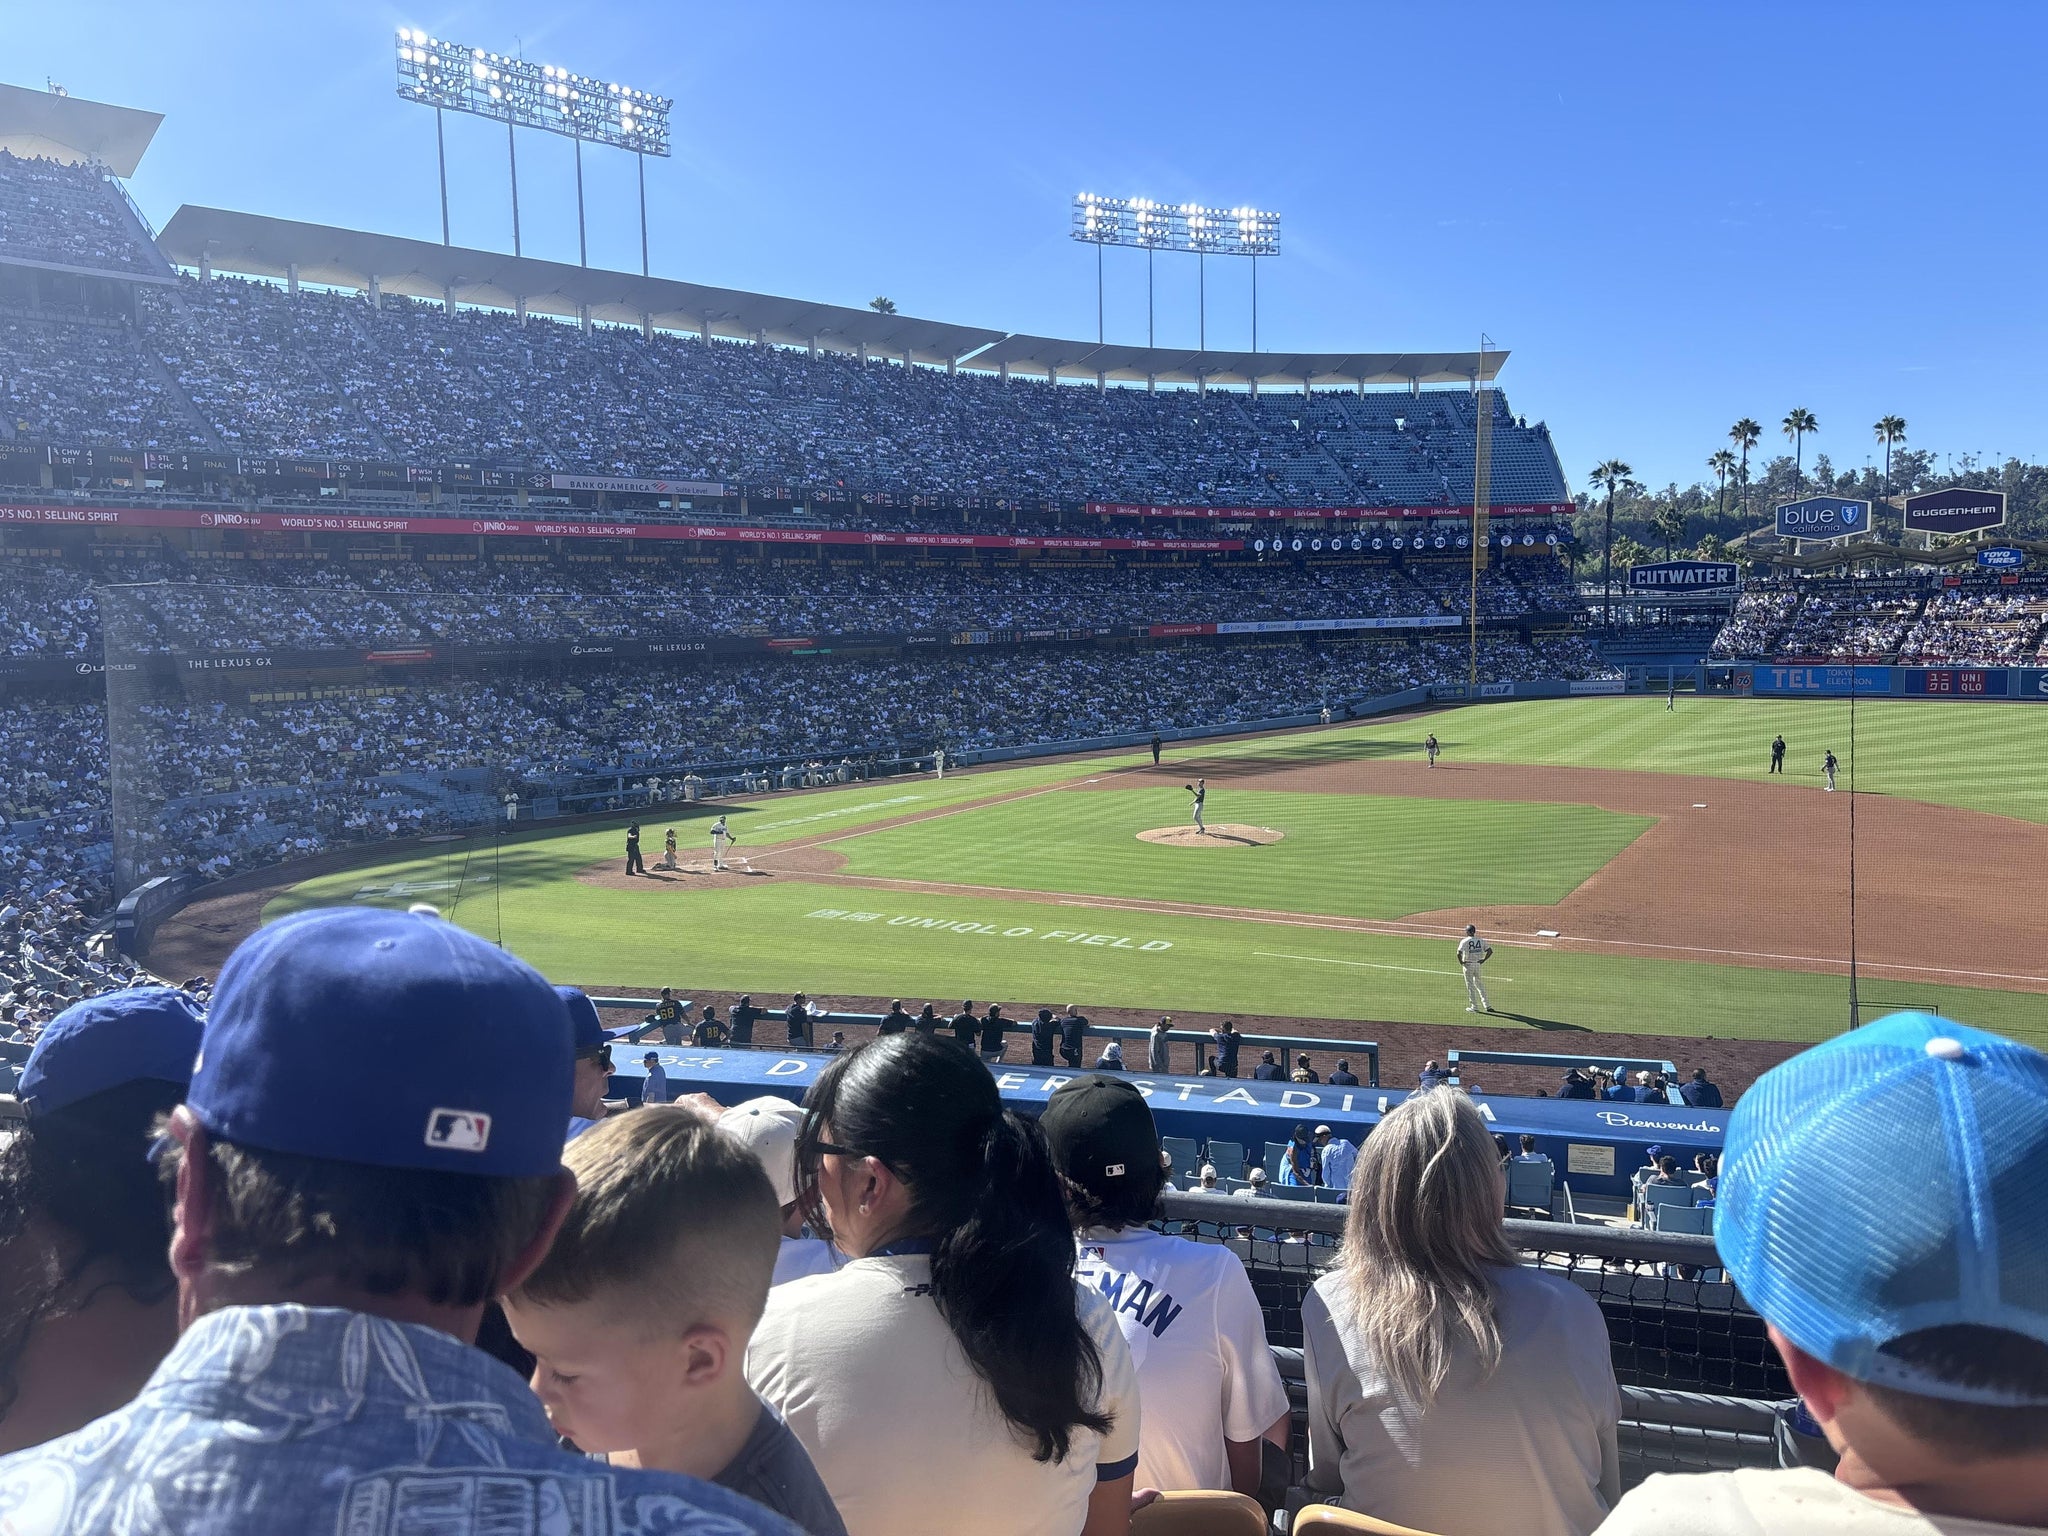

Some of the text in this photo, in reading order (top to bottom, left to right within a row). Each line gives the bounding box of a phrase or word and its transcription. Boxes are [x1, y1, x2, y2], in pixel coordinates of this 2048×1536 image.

[87, 458, 93, 466] 3
[109, 455, 134, 464] FINAL
[204, 461, 227, 469] FINAL
[378, 470, 398, 478] FINAL
[570, 481, 650, 492] BANK OF AMERICA
[675, 486, 708, 495] Suite Level
[17, 509, 41, 519] NO.1
[45, 510, 85, 520] SELLING
[87, 512, 119, 522] SPIRIT
[1785, 506, 1834, 525] blue
[1912, 506, 1996, 517] GUGGENHEIM
[214, 513, 242, 526] JINRO
[281, 518, 408, 530] WORLD'S NO.1 SELLING SPIRIT
[483, 522, 506, 532] JINRO
[535, 524, 637, 536] WORLD'S NO.1 SELLING SPIRIT
[1792, 524, 1840, 533] california
[697, 528, 716, 537] JINRO
[739, 530, 766, 538] WORLD'S
[781, 532, 805, 540] SELLING
[871, 534, 887, 543] JINRO
[1458, 538, 1466, 546] 42
[1636, 567, 1728, 584] CUTWATER
[1573, 614, 1587, 622] 4:41
[666, 643, 692, 651] LEXUS
[188, 657, 272, 669] THE LEXUS GX
[1736, 675, 1750, 686] 76
[1772, 669, 1820, 689] TEL
[1826, 678, 1872, 686] ELECTRON
[1930, 673, 1949, 681] ユニ
[1961, 673, 1981, 682] UNI
[1483, 685, 1501, 695] ANA
[1929, 683, 1949, 691] クロ
[1961, 683, 1982, 692] QLO
[887, 915, 1034, 937] UNIQLO
[1040, 929, 1173, 951] FIELD
[1468, 940, 1482, 950] 84
[660, 1007, 675, 1020] 68
[765, 1058, 1075, 1092] DER
[1596, 1111, 1721, 1133] Bienvenido
[1078, 1270, 1183, 1339] MAN
